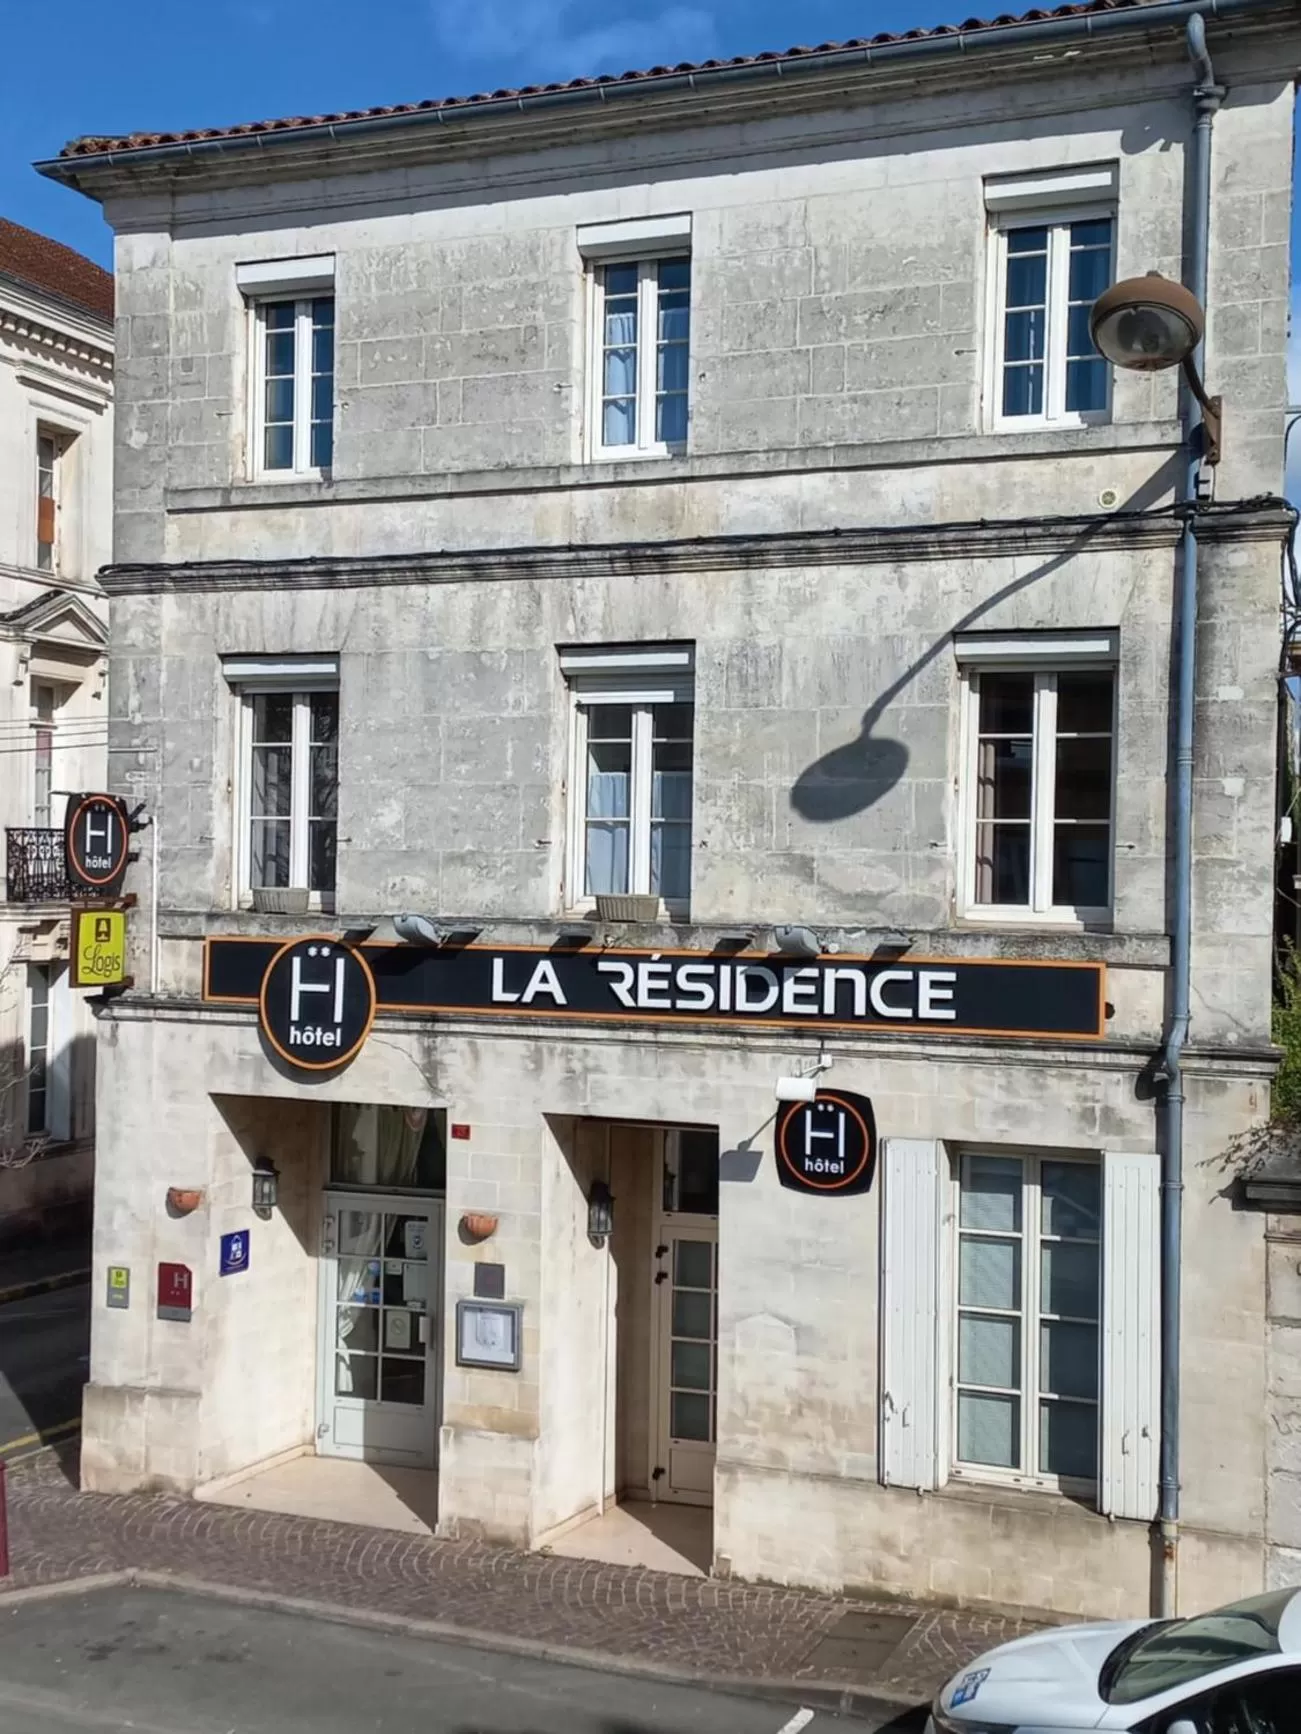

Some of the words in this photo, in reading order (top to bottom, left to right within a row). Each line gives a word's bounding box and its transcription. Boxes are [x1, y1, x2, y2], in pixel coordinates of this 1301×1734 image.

[85, 855, 112, 869] hôtel
[81, 943, 121, 978] Logis
[290, 956, 345, 1023] H
[492, 957, 567, 1005] LA
[597, 953, 957, 1020] RÉSIDENCE
[289, 1025, 341, 1047] hôtel
[805, 1109, 845, 1158] H
[804, 1157, 844, 1174] hôtel
